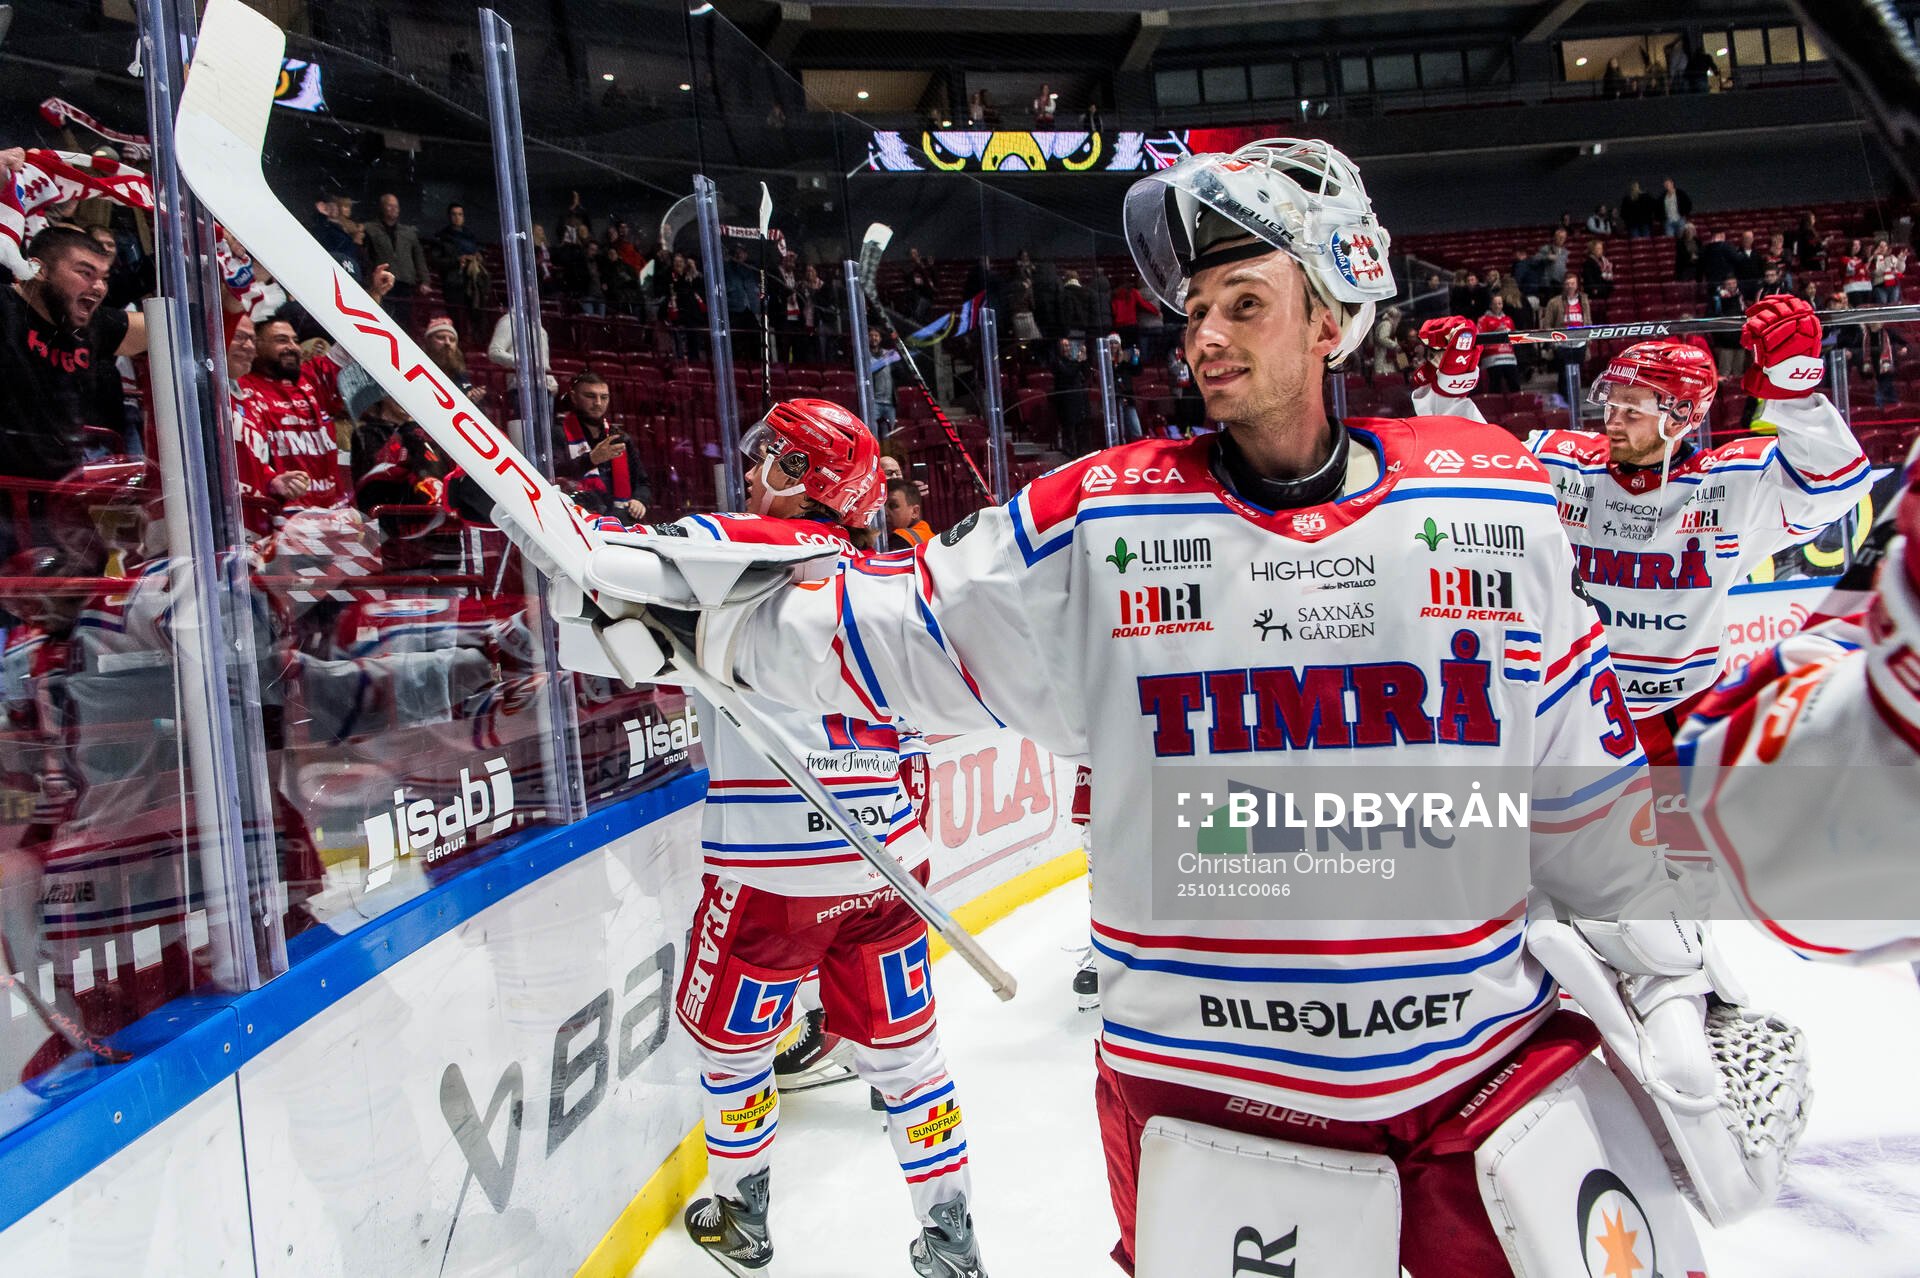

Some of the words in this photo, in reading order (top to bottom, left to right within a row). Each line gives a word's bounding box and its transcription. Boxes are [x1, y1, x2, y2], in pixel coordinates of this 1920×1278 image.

[1471, 454, 1539, 472] SCA
[1123, 467, 1186, 485] SCA
[1605, 500, 1663, 517] HIGHCON
[1451, 522, 1525, 551] LILIUM
[1140, 538, 1212, 564] LILIUM
[1454, 547, 1525, 558] FASTIGHETER
[1142, 563, 1212, 572] FASTIGHETER
[1250, 555, 1375, 581] HIGHCON
[1337, 579, 1376, 589] INSTALCO
[1298, 602, 1375, 623] SAXNÄS
[1420, 607, 1463, 619] ROAD
[1466, 610, 1525, 622] RENTAL
[1616, 610, 1687, 631] NHC
[1111, 624, 1152, 639] ROAD
[1154, 620, 1215, 636] RENTAL
[1299, 623, 1375, 641] GÅRDEN
[1137, 629, 1501, 757] TIMRÅ
[663, 750, 689, 766] GROUP
[806, 751, 840, 771] from
[842, 750, 881, 772] Timrå
[427, 836, 466, 863] GROUP
[687, 876, 744, 1006] PEAB
[1199, 989, 1473, 1039] BILBOLAGET
[1460, 1062, 1522, 1118] BAUER
[725, 1096, 778, 1122] SUNDFRAKT
[1224, 1096, 1331, 1130] BAUER
[912, 1111, 961, 1138] SUNDFRAKT
